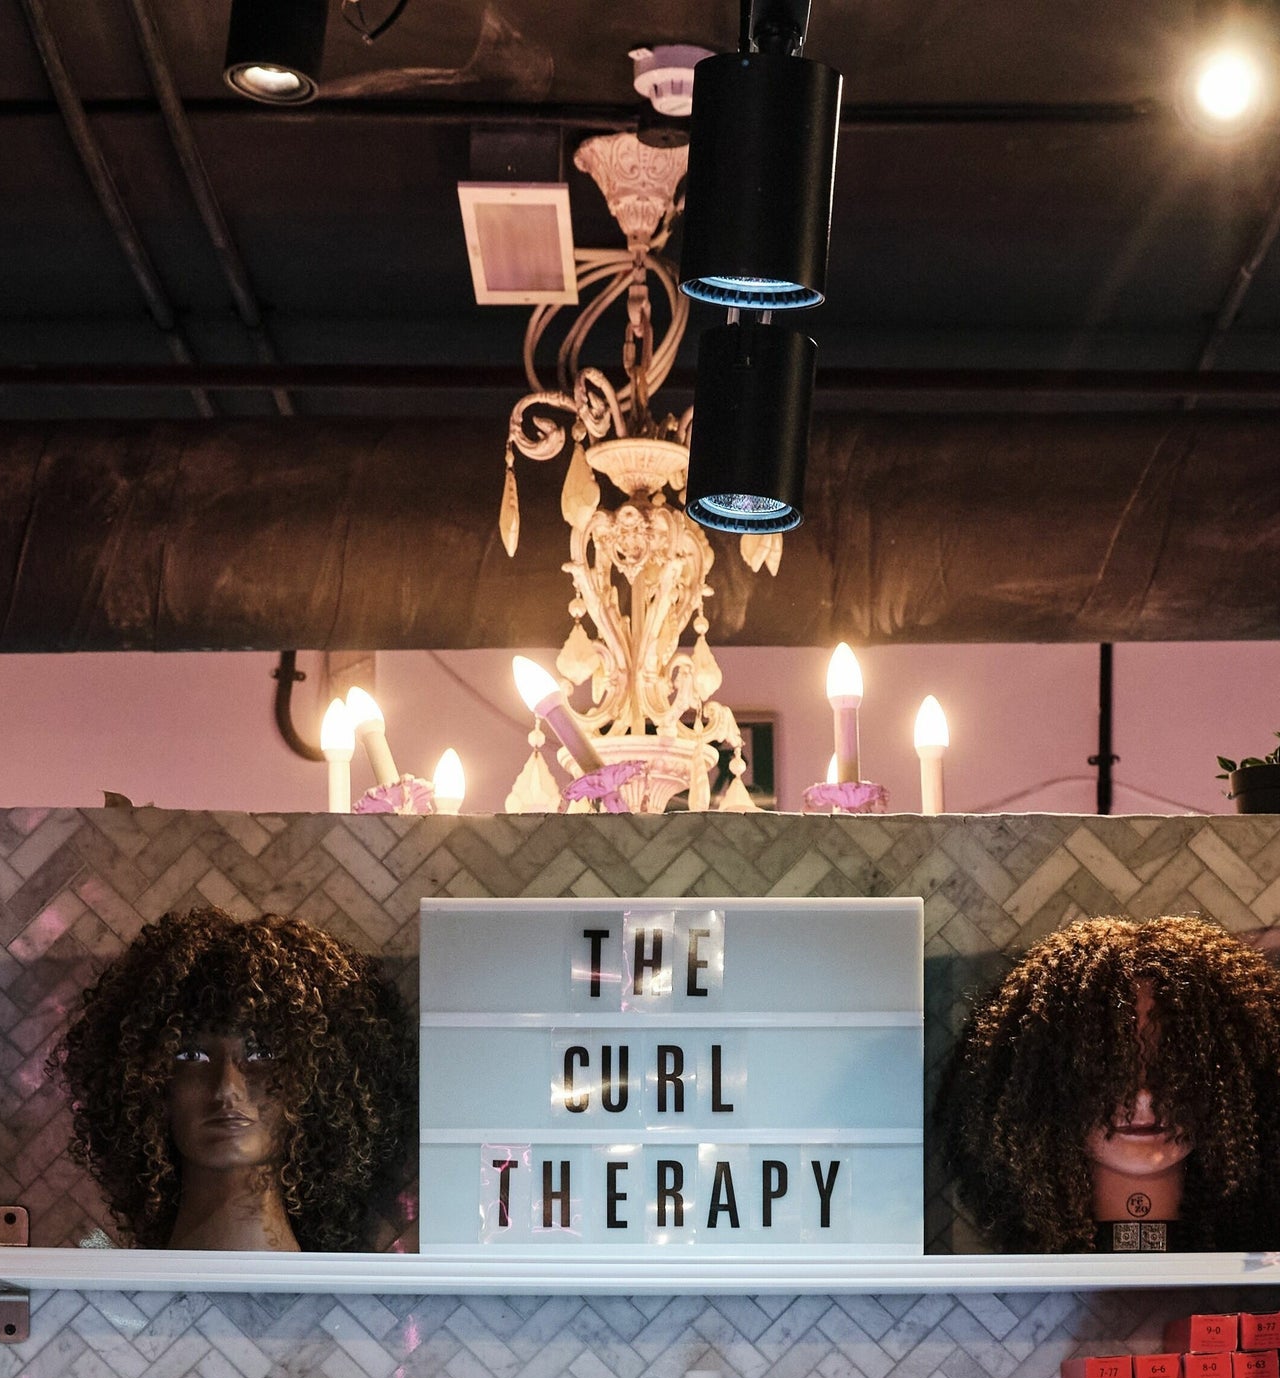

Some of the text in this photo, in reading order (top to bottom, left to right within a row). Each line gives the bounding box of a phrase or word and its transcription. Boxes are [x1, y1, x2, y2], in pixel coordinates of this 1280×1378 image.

[583, 928, 711, 997] THE
[563, 1044, 735, 1114] CURL
[491, 1159, 841, 1229] THERAPY
[1206, 1325, 1221, 1335] 9-0
[1257, 1322, 1276, 1332] 8-77
[1151, 1364, 1166, 1374] 6-6
[1202, 1363, 1217, 1372] 8-0
[1246, 1360, 1266, 1370] 6-63
